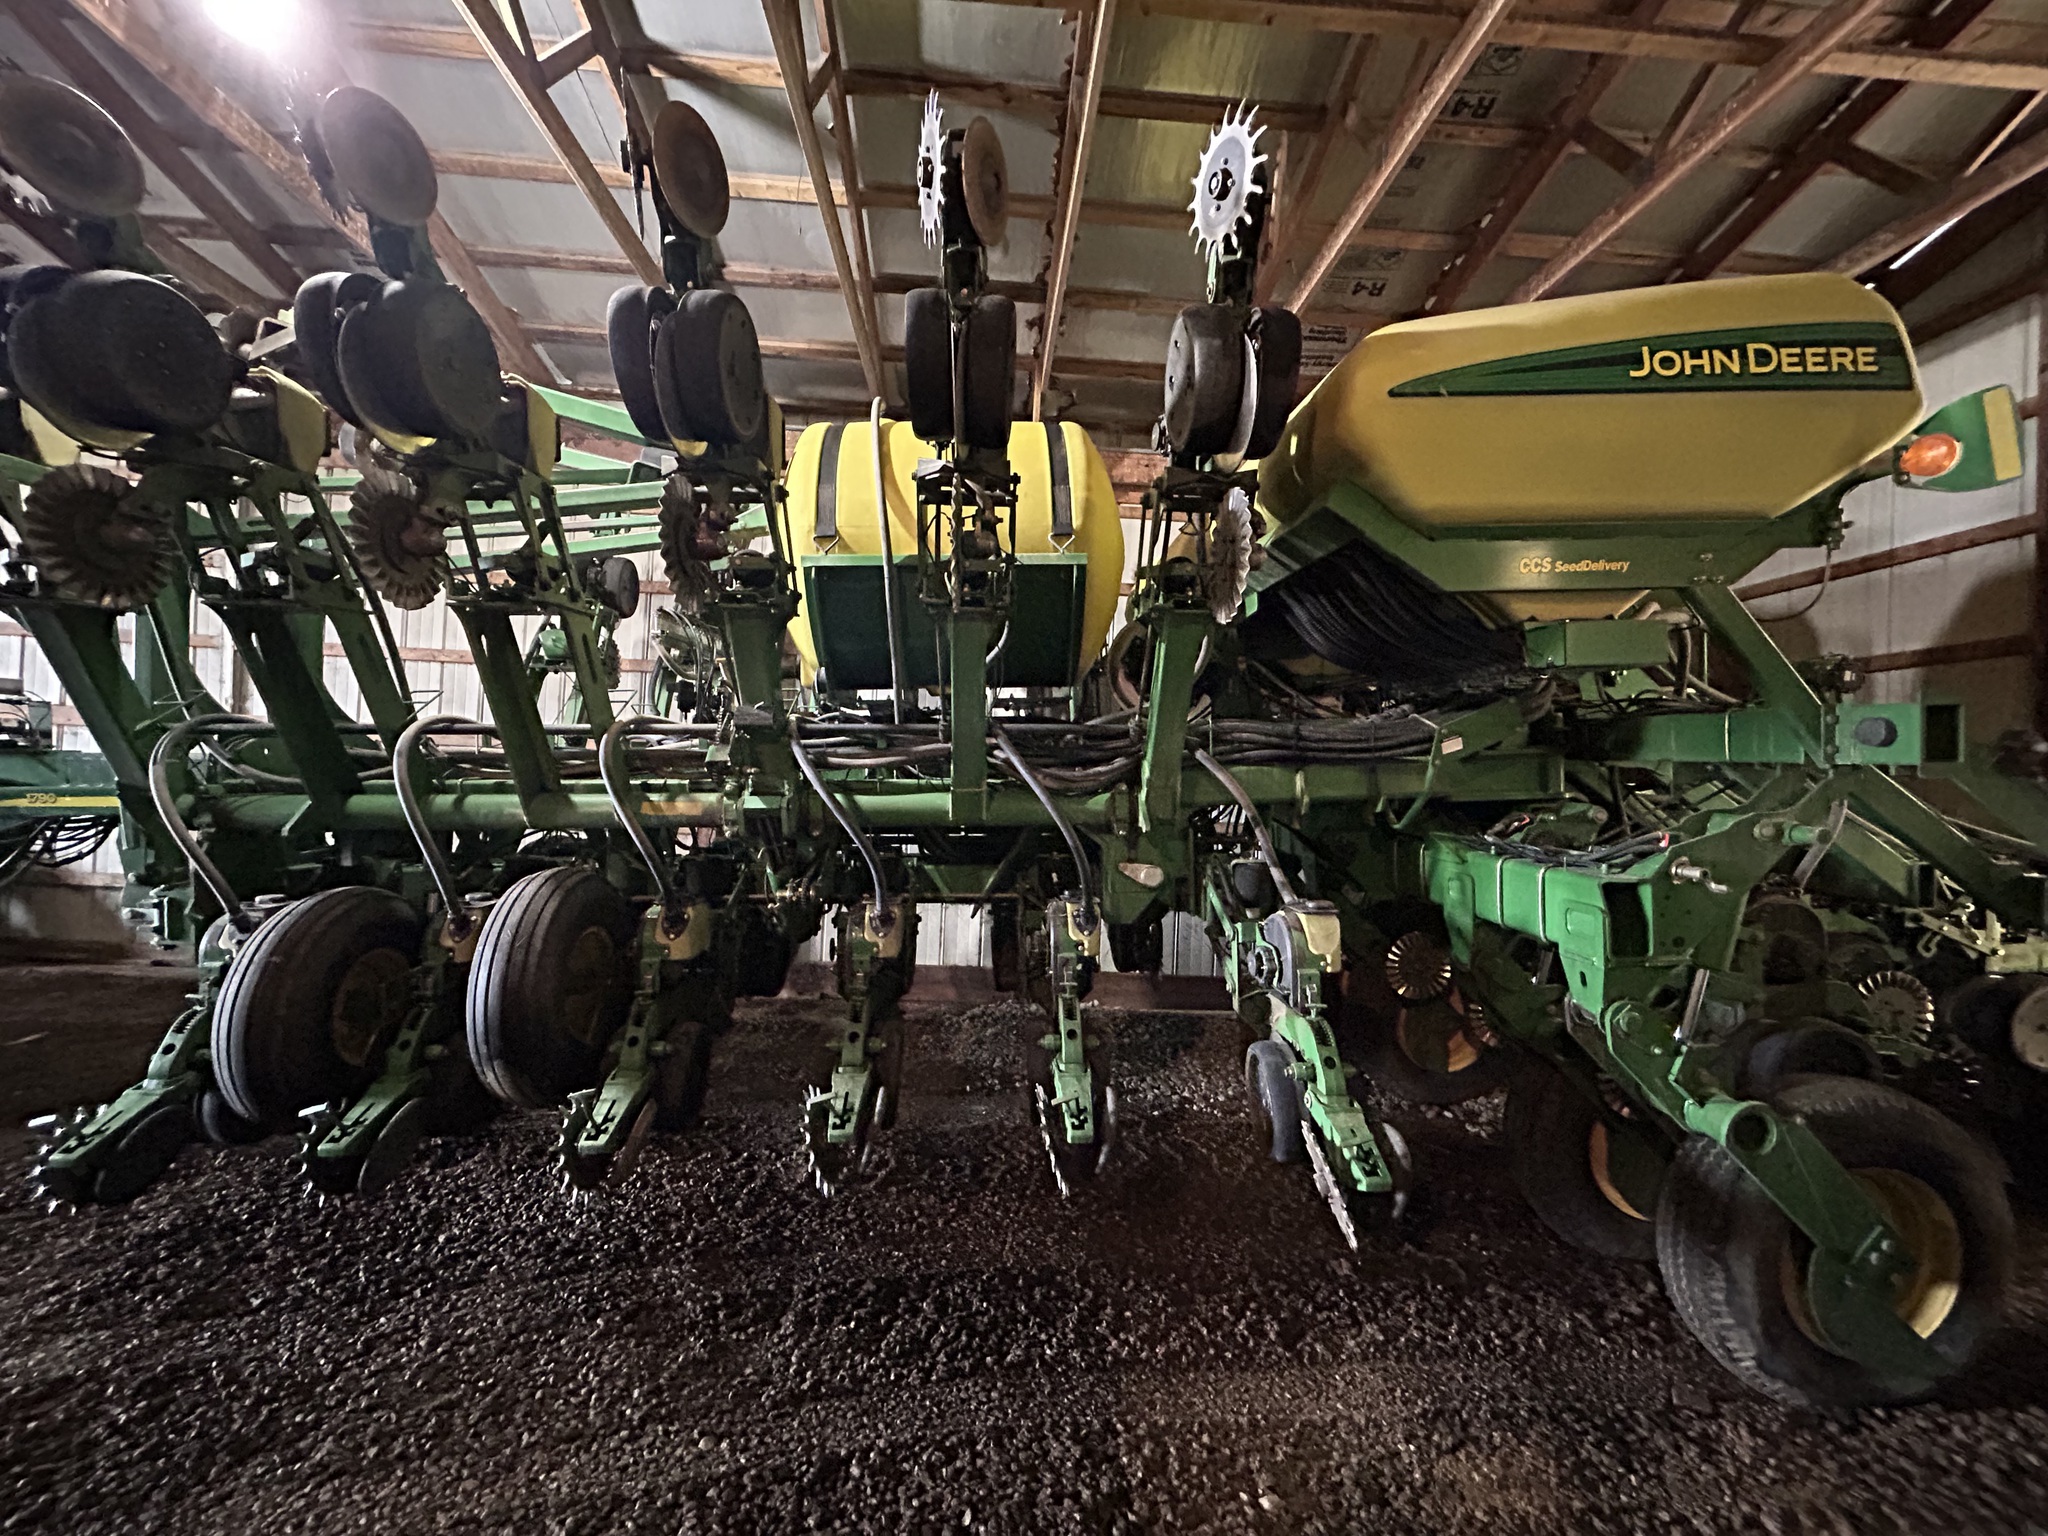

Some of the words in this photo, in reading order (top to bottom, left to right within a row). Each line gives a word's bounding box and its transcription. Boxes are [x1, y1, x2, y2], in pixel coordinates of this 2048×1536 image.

[1629, 346, 1741, 377] JOHN
[1746, 343, 1879, 374] DEERE
[1520, 557, 1552, 573] CCS
[1554, 560, 1630, 573] SeedDelivery
